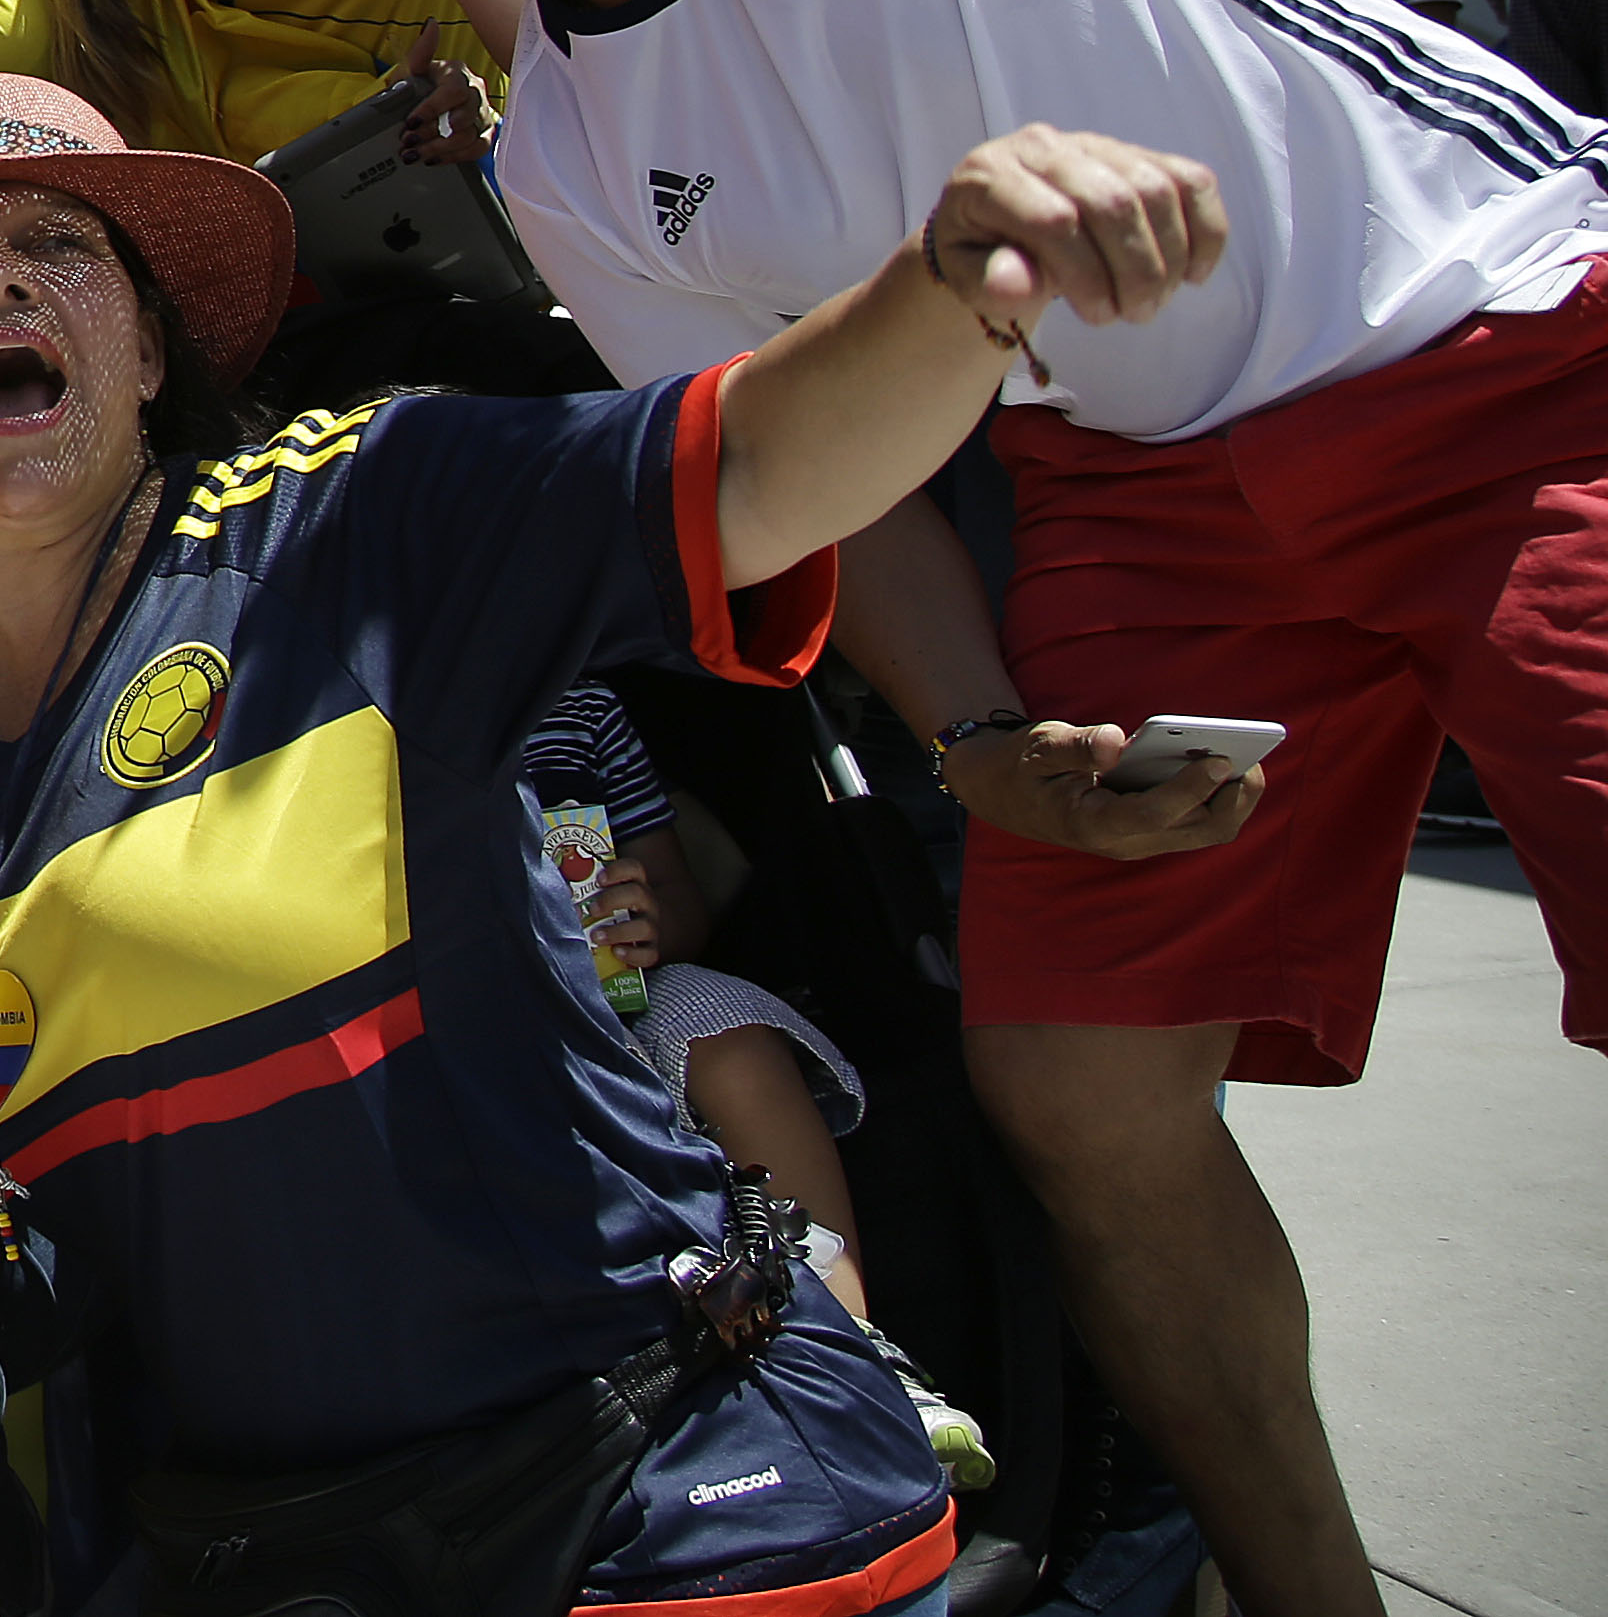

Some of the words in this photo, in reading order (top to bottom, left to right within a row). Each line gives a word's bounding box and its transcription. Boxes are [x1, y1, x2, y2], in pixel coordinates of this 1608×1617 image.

[663, 172, 715, 246] adidas
[193, 652, 208, 667] DE
[687, 1464, 782, 1505] climacool
